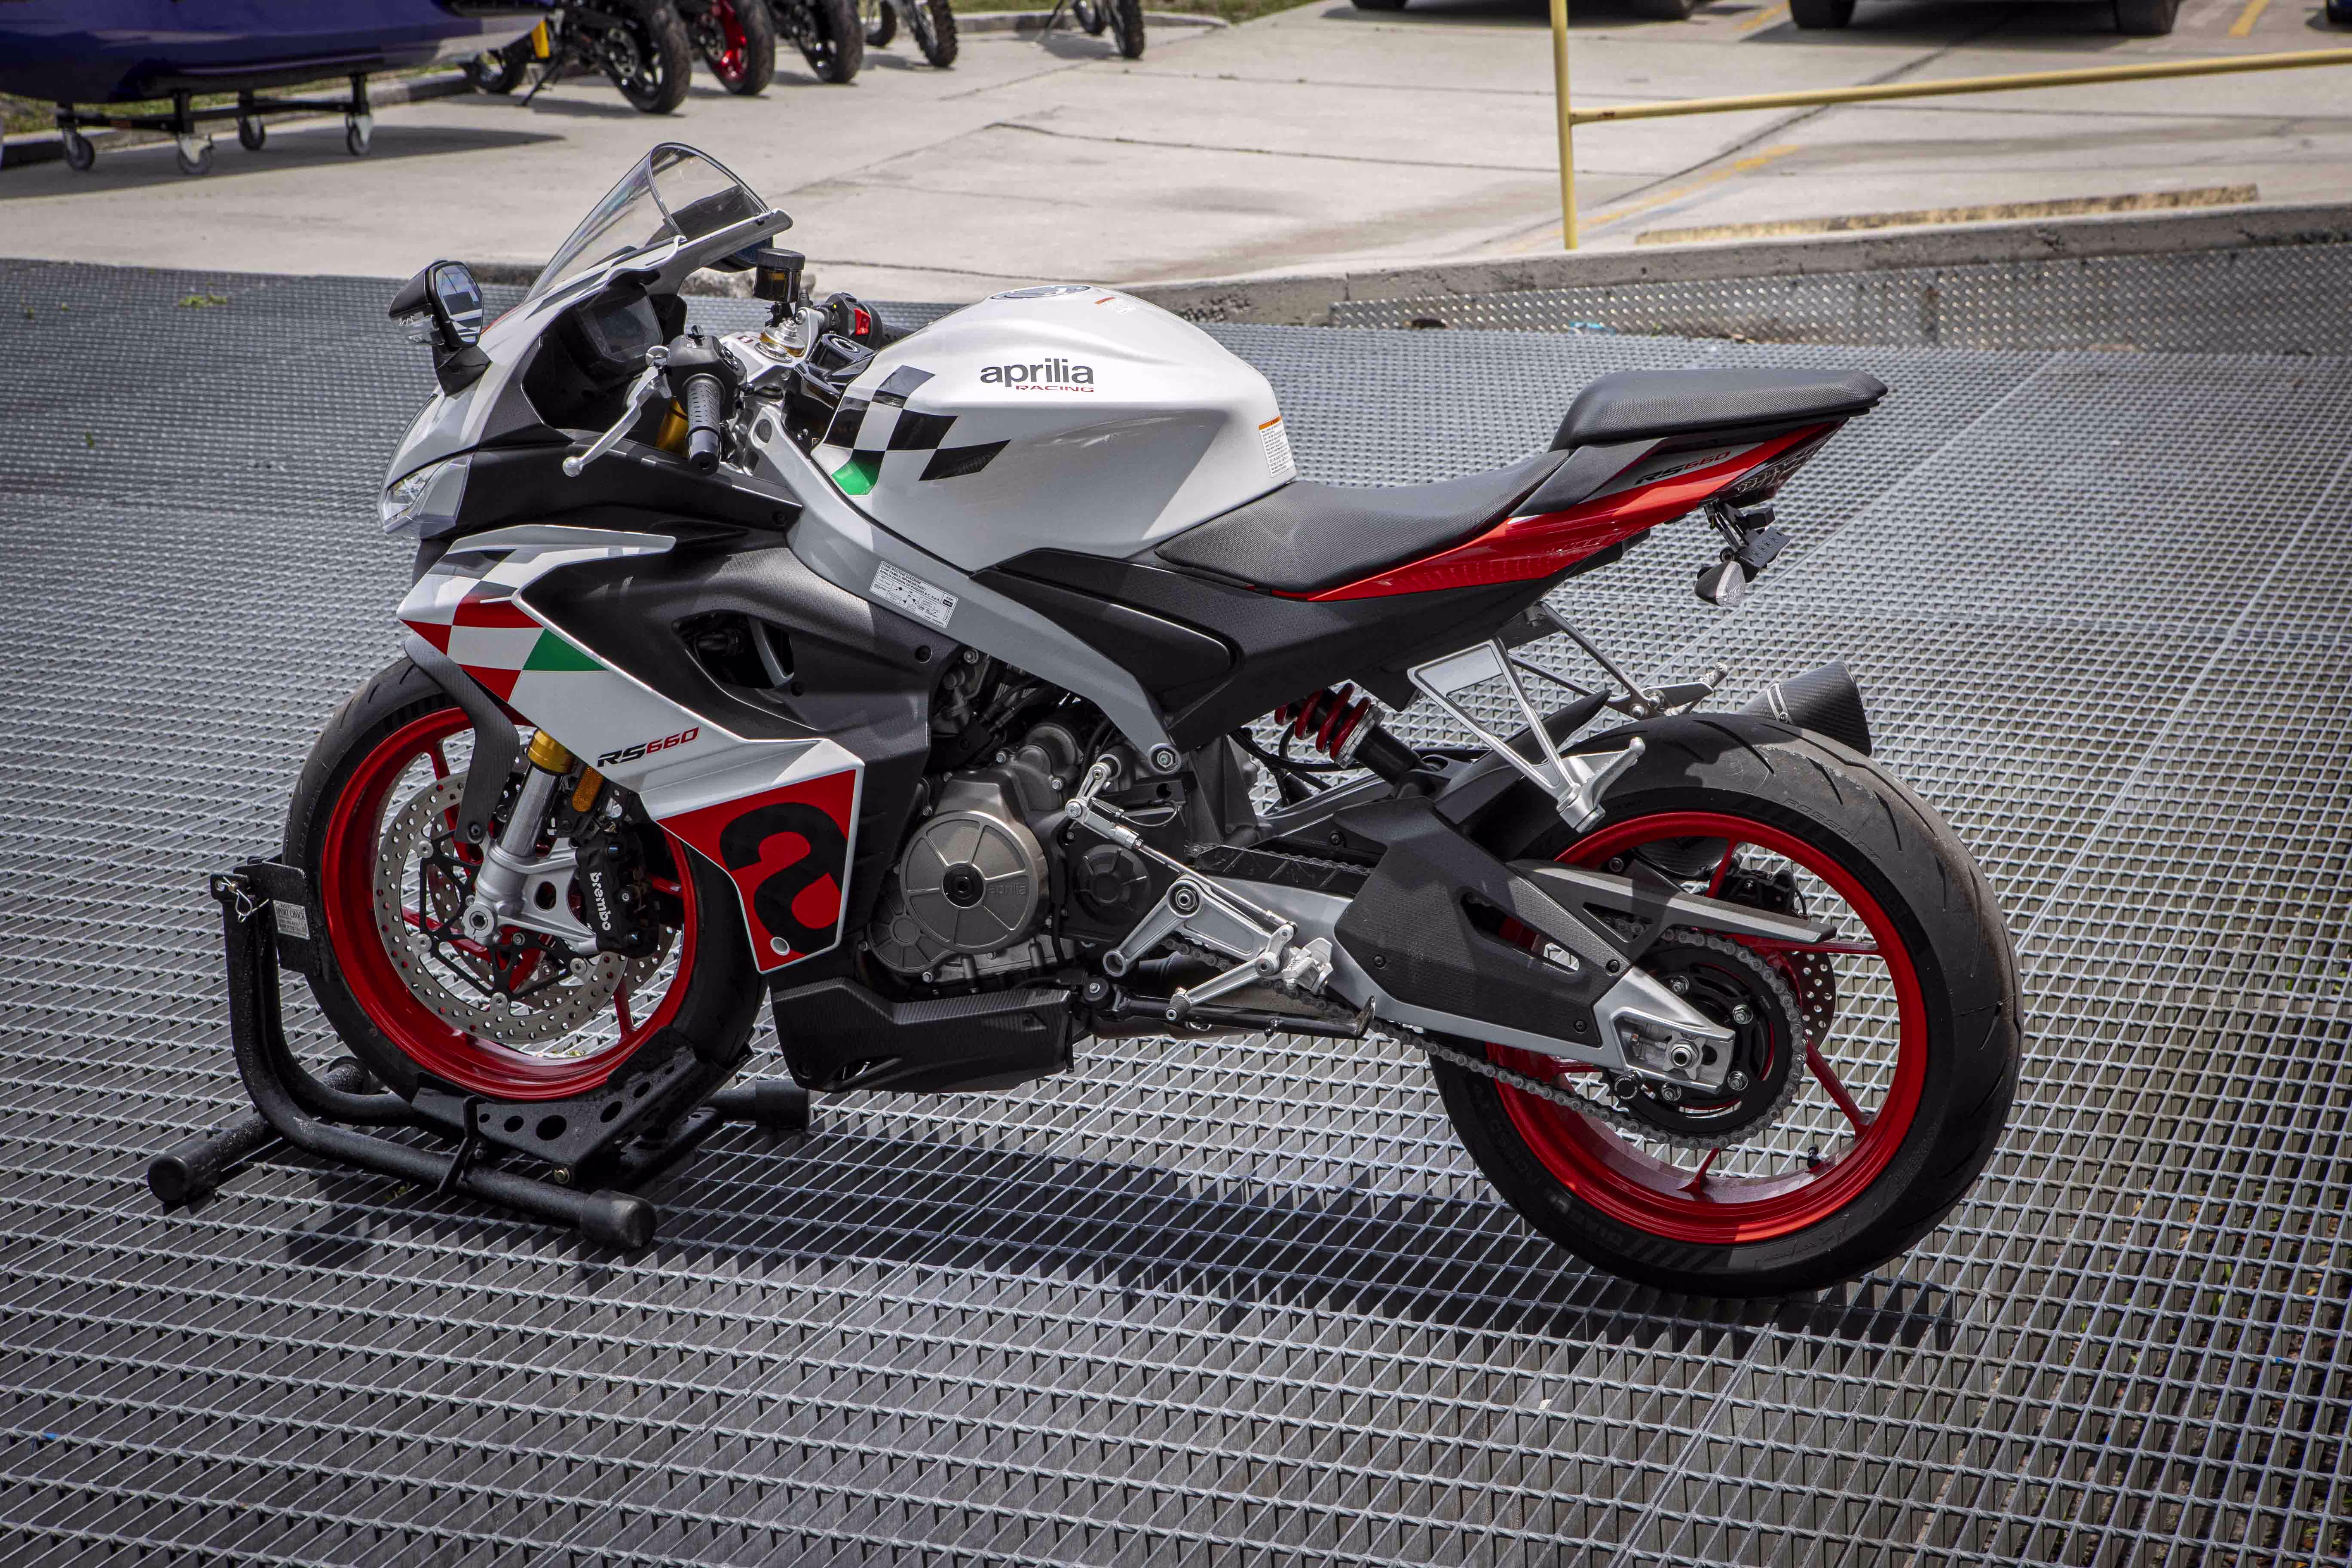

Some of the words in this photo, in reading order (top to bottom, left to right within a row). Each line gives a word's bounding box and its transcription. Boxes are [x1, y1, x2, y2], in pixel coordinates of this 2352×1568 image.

[980, 358, 1093, 387] aprilia
[1635, 450, 1731, 485] RS660
[879, 570, 892, 578] APRILIA
[892, 576, 906, 585] DIVISION
[910, 585, 925, 594] PIAGGIO
[905, 575, 921, 584] DIAGRAM
[597, 726, 699, 768] RS660
[590, 872, 611, 931] brembo
